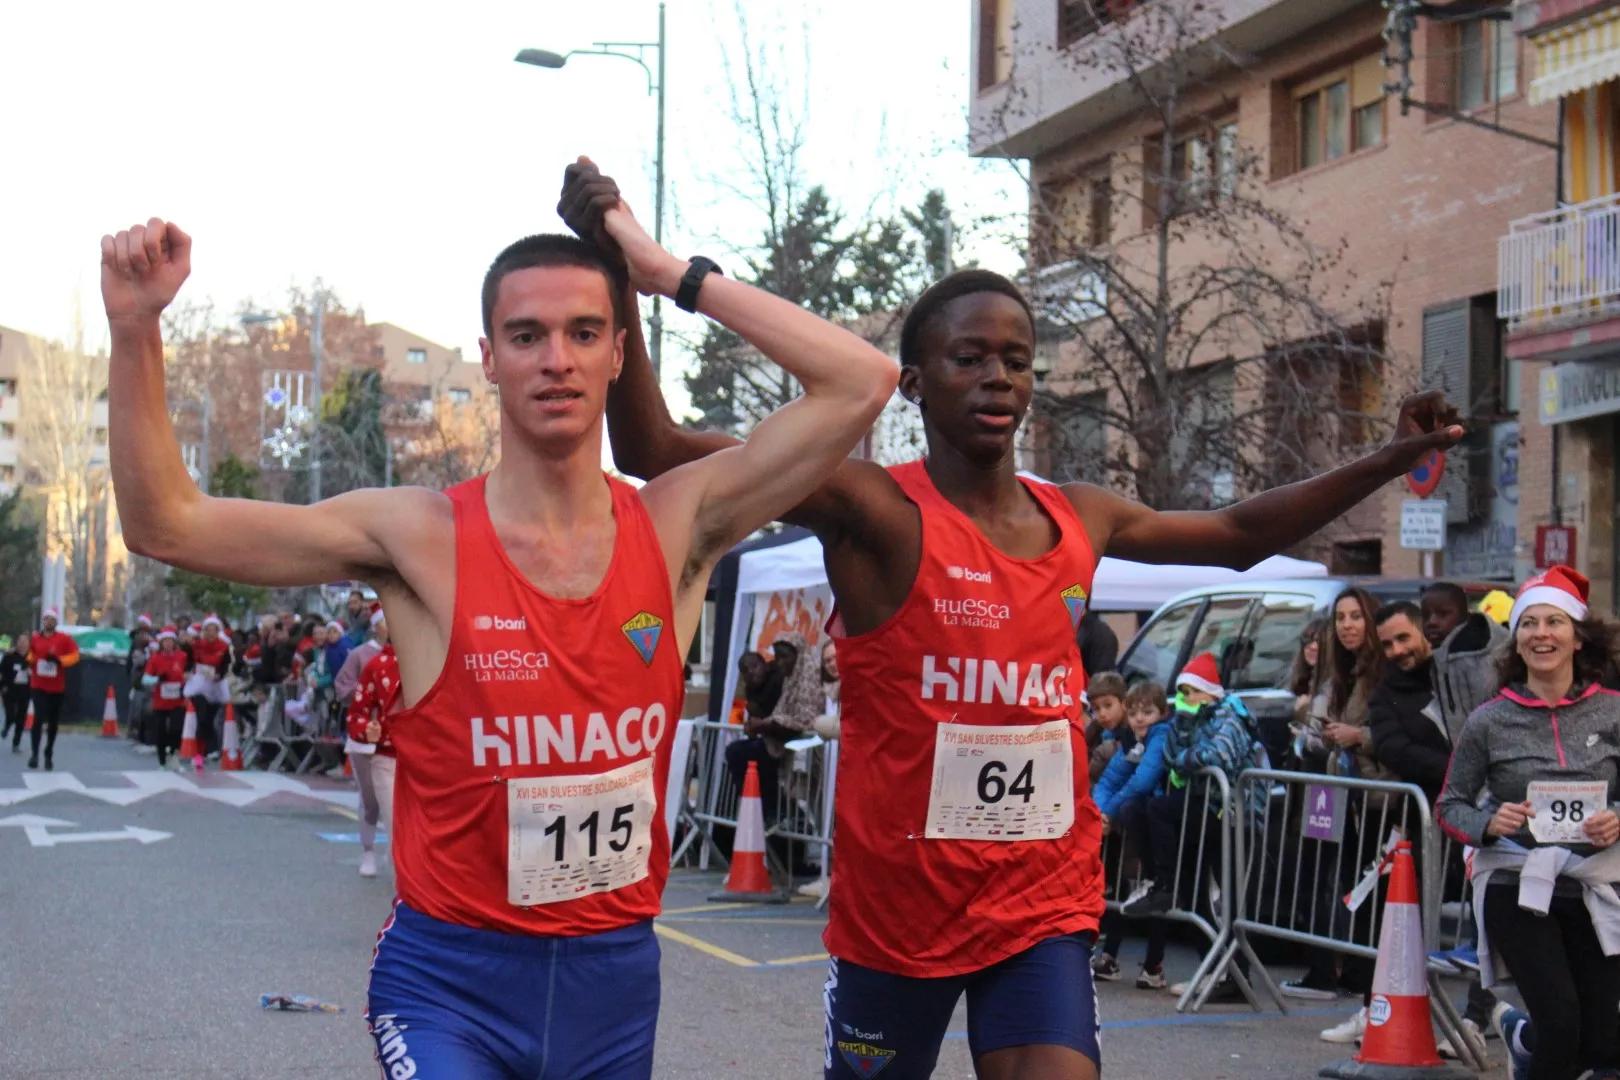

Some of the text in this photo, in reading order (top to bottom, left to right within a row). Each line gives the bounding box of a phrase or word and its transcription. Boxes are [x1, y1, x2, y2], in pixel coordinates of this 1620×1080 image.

[965, 568, 992, 584] barri
[494, 615, 526, 630] barri
[471, 703, 666, 767] HINACO
[958, 732, 973, 744] SAN
[974, 732, 1012, 745] SILVESTRE
[516, 787, 530, 800] XVI
[532, 787, 548, 800] SAN
[550, 783, 593, 798] SILVESTRE
[594, 775, 628, 794] SOLIDARIA
[977, 759, 1035, 804] 64
[1550, 799, 1584, 822] 98
[544, 803, 634, 862] 115
[854, 1028, 883, 1040] barri
